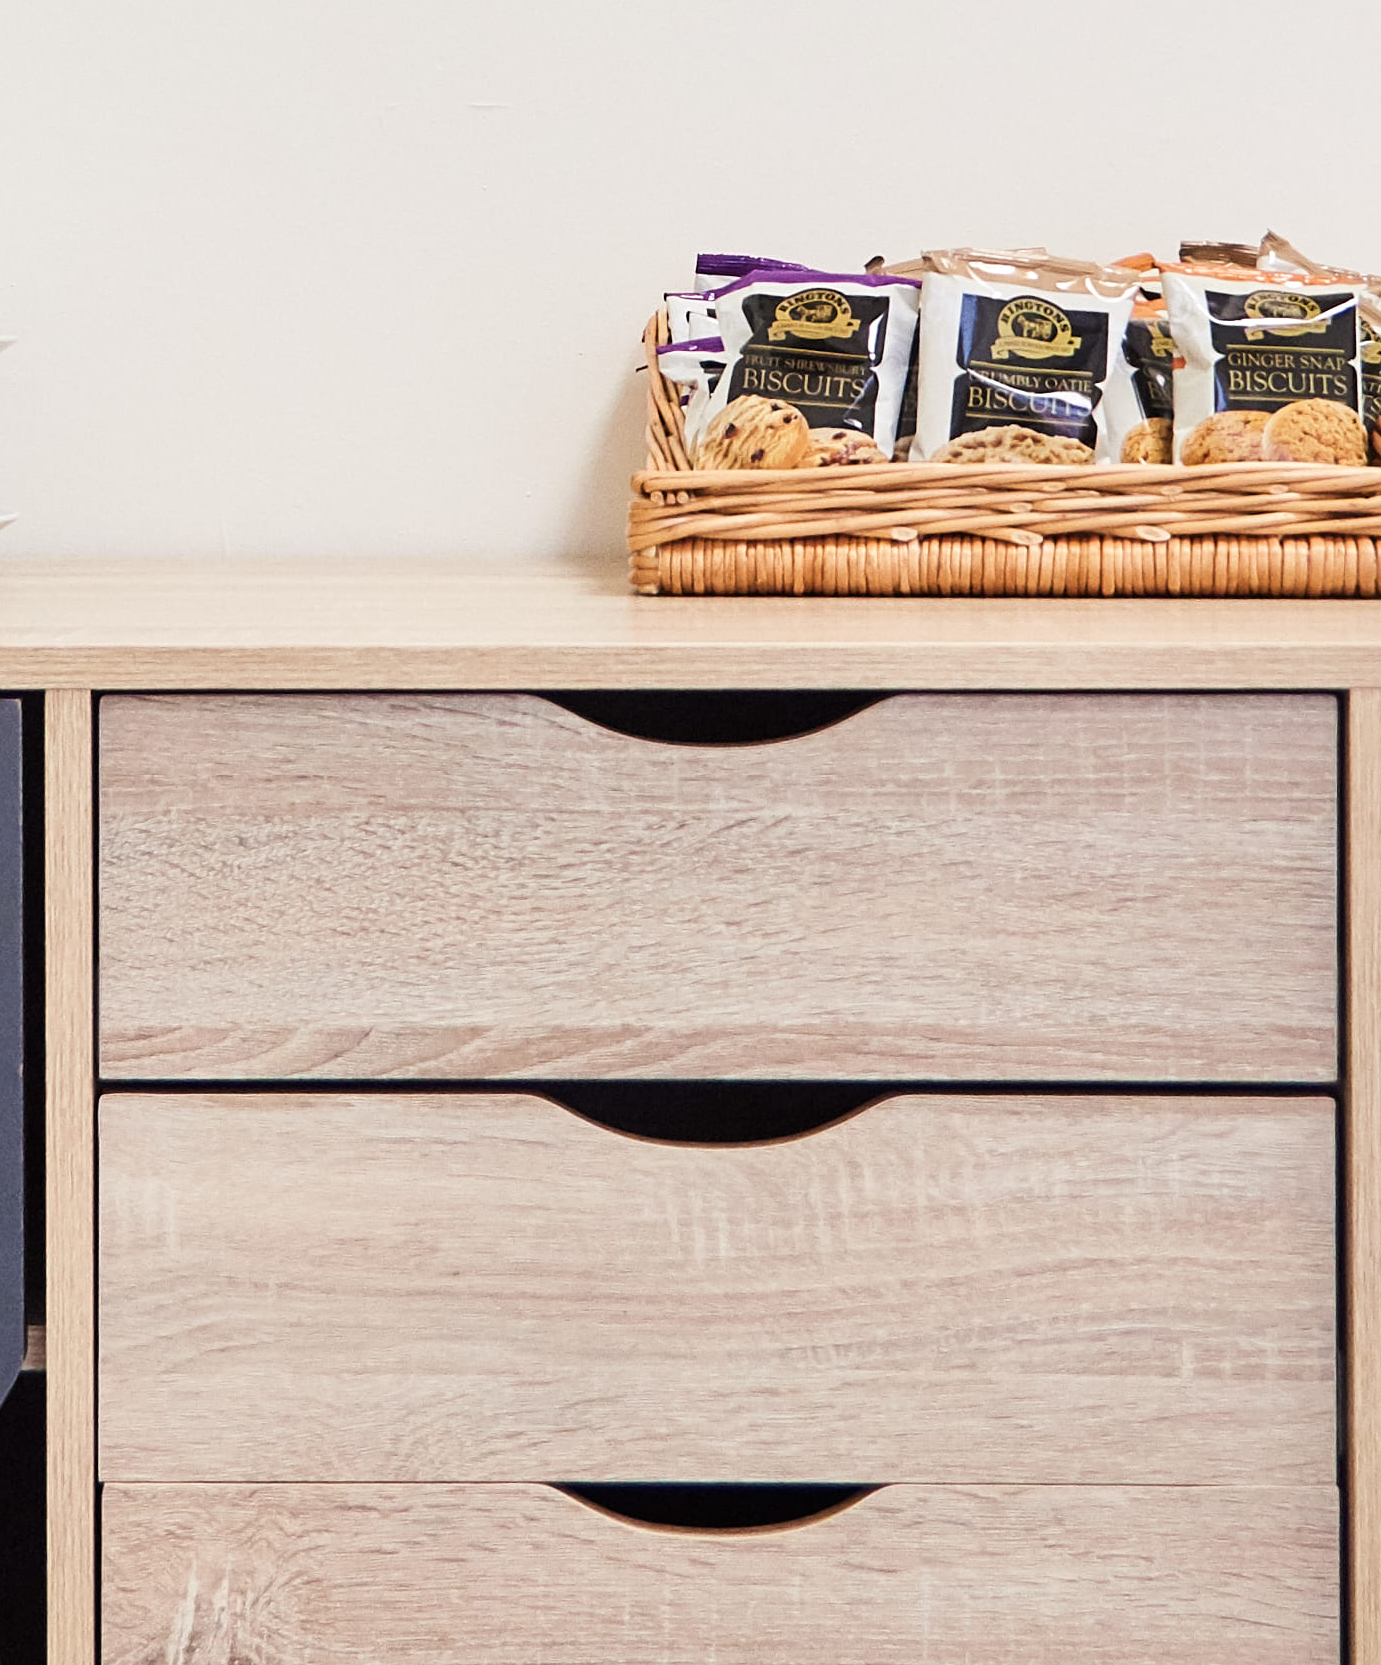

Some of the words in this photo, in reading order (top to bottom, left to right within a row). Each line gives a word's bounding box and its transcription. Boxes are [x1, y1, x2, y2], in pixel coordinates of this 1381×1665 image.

[778, 292, 850, 314] RINGTONS
[1248, 294, 1318, 313] RIONS
[1001, 301, 1070, 333] RINGTONS
[745, 354, 780, 368] FRUIT
[784, 359, 866, 377] SHREWSBURY
[1227, 352, 1296, 368] GINGER
[1299, 355, 1347, 372] SNAP
[742, 367, 867, 399] BISCUITS
[1045, 376, 1093, 393] OATIE
[1228, 369, 1348, 396] BISCUITS
